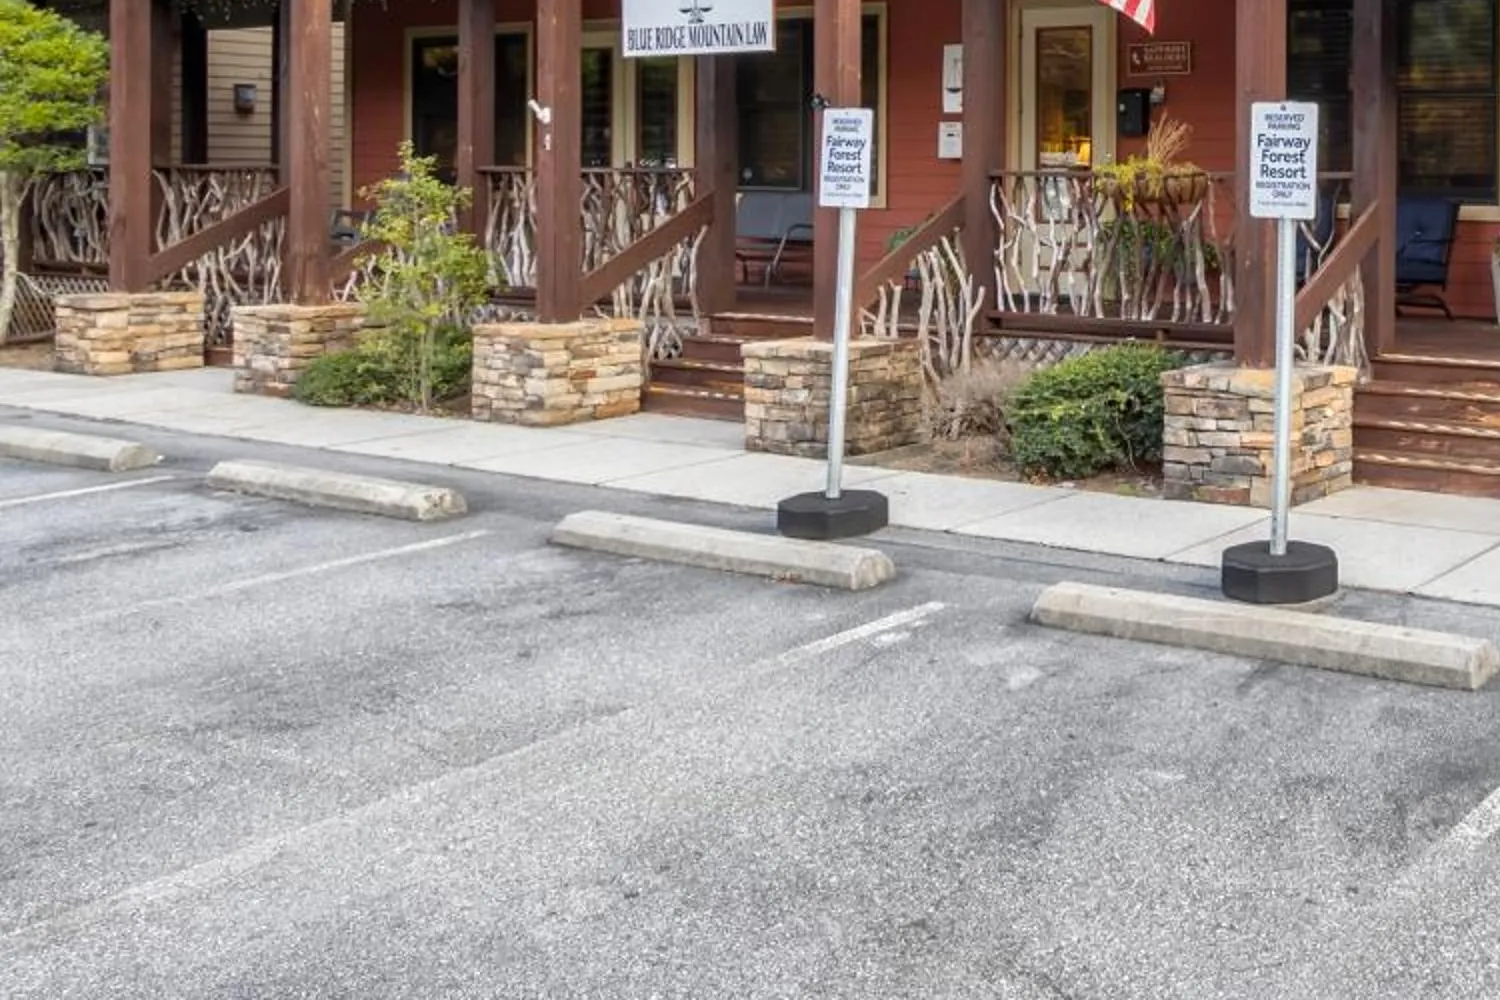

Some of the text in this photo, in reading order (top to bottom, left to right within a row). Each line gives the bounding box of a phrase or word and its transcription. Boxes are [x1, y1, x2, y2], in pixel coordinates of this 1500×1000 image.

[627, 21, 768, 51] BLUE RIDGE MOUNTAIN LAW
[827, 135, 866, 150] Fairway
[1257, 133, 1311, 151] Fairway
[829, 147, 862, 160] Forest
[1261, 149, 1306, 164] Forest
[827, 161, 862, 174] Resort
[1260, 164, 1307, 179] Resort
